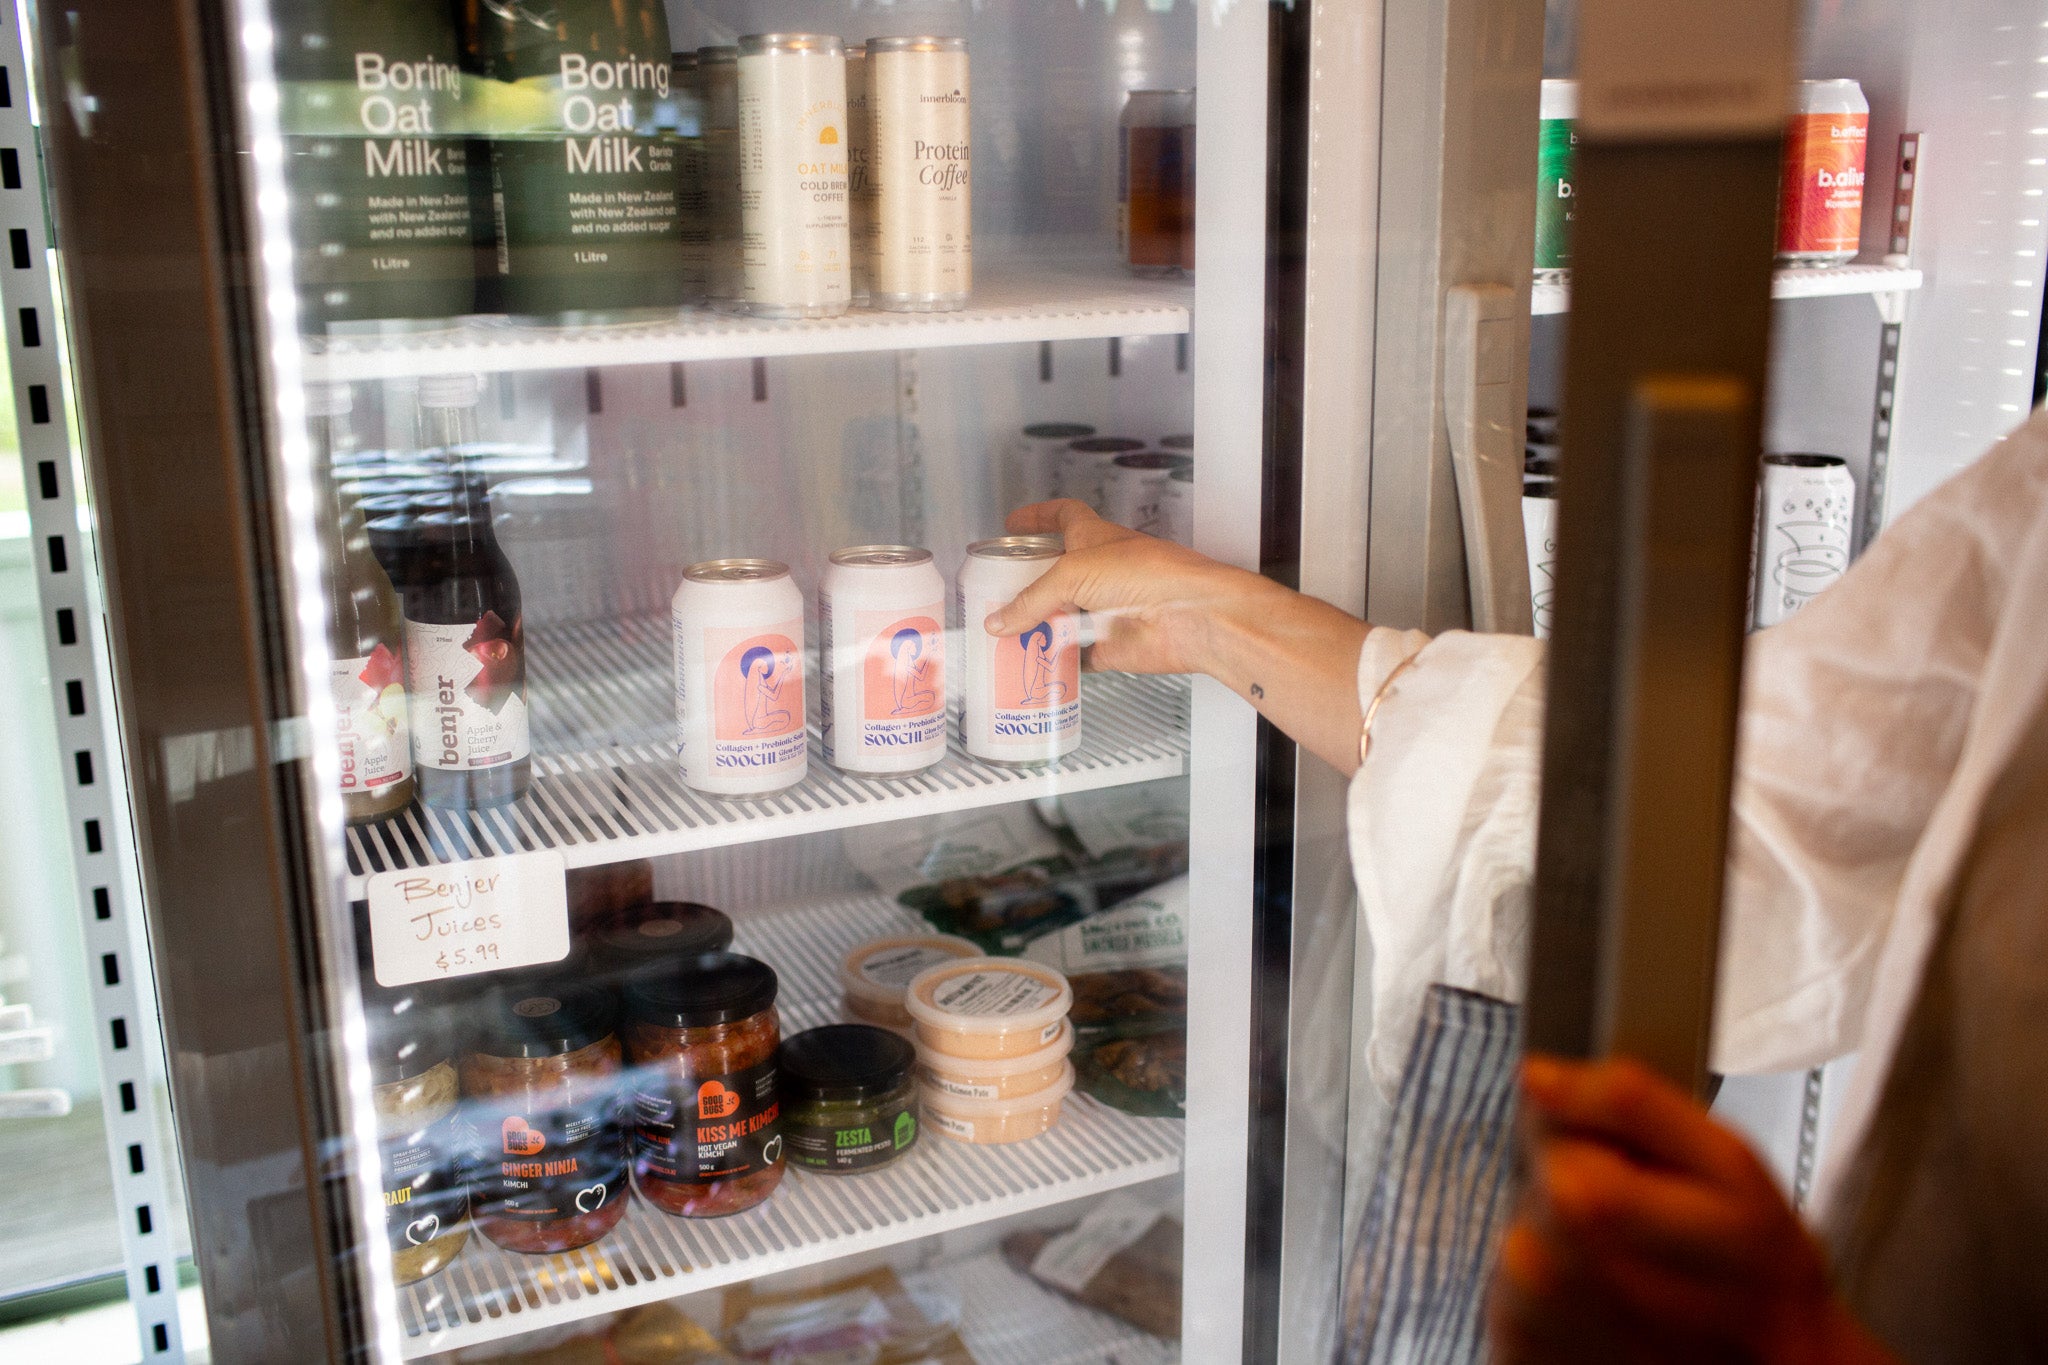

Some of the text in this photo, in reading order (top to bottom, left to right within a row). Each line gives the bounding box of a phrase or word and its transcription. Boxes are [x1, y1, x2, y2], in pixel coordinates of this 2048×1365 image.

[355, 52, 461, 100] Boring
[560, 53, 669, 99] Boring
[360, 95, 433, 134] Oat
[563, 94, 634, 133] Oat
[565, 136, 643, 175] Milk
[914, 140, 969, 161] Protein
[365, 139, 443, 178] Milk
[797, 162, 826, 175] OAT
[919, 164, 968, 191] Coffee
[800, 181, 828, 191] COLD
[368, 196, 404, 208] Made
[406, 196, 418, 207] in
[420, 195, 441, 207] New
[569, 191, 601, 205] Made
[604, 191, 616, 204] in
[618, 190, 642, 204] New
[813, 193, 844, 203] COFFEE
[369, 211, 397, 224] with
[400, 211, 426, 223] New
[570, 207, 596, 220] with
[598, 206, 624, 219] New
[626, 205, 663, 218] Zealand
[369, 226, 395, 240] and
[396, 228, 413, 239] no
[415, 226, 448, 238] added
[571, 221, 593, 235] and
[595, 223, 610, 234] no
[612, 220, 647, 232] added
[380, 257, 411, 270] Litre
[574, 252, 608, 264] 1 Litre
[435, 674, 465, 767] benjer
[995, 711, 1031, 722] Collagen
[466, 722, 502, 737] Apple &
[864, 722, 901, 733] Collagen
[908, 716, 937, 730] Prebiotic
[995, 721, 1052, 736] SOOCHI
[467, 735, 498, 747] Cherry
[715, 742, 754, 754] Collagen
[761, 736, 793, 750] Prebiotic
[864, 730, 922, 747] SOOCHI
[467, 745, 490, 756] Juice
[363, 754, 388, 769] Apple
[715, 751, 776, 768] SOOCHI
[364, 765, 386, 777] Juice
[394, 873, 500, 909] Benjer
[411, 905, 502, 941] Juices
[436, 942, 500, 973] $5.99
[702, 1094, 723, 1105] GOOD
[703, 1104, 724, 1115] BUGS
[507, 1130, 528, 1141] GOOD
[697, 1125, 727, 1143] KISS
[729, 1119, 747, 1139] ME
[835, 1128, 872, 1148] ZESTA
[507, 1141, 529, 1151] BUGS
[698, 1140, 738, 1153] HOT VEGAN
[698, 1150, 725, 1159] KIMCHI
[502, 1157, 578, 1178] GINGER NINJA
[503, 1179, 529, 1189] KIMCHI
[384, 1186, 412, 1206] RAUT
